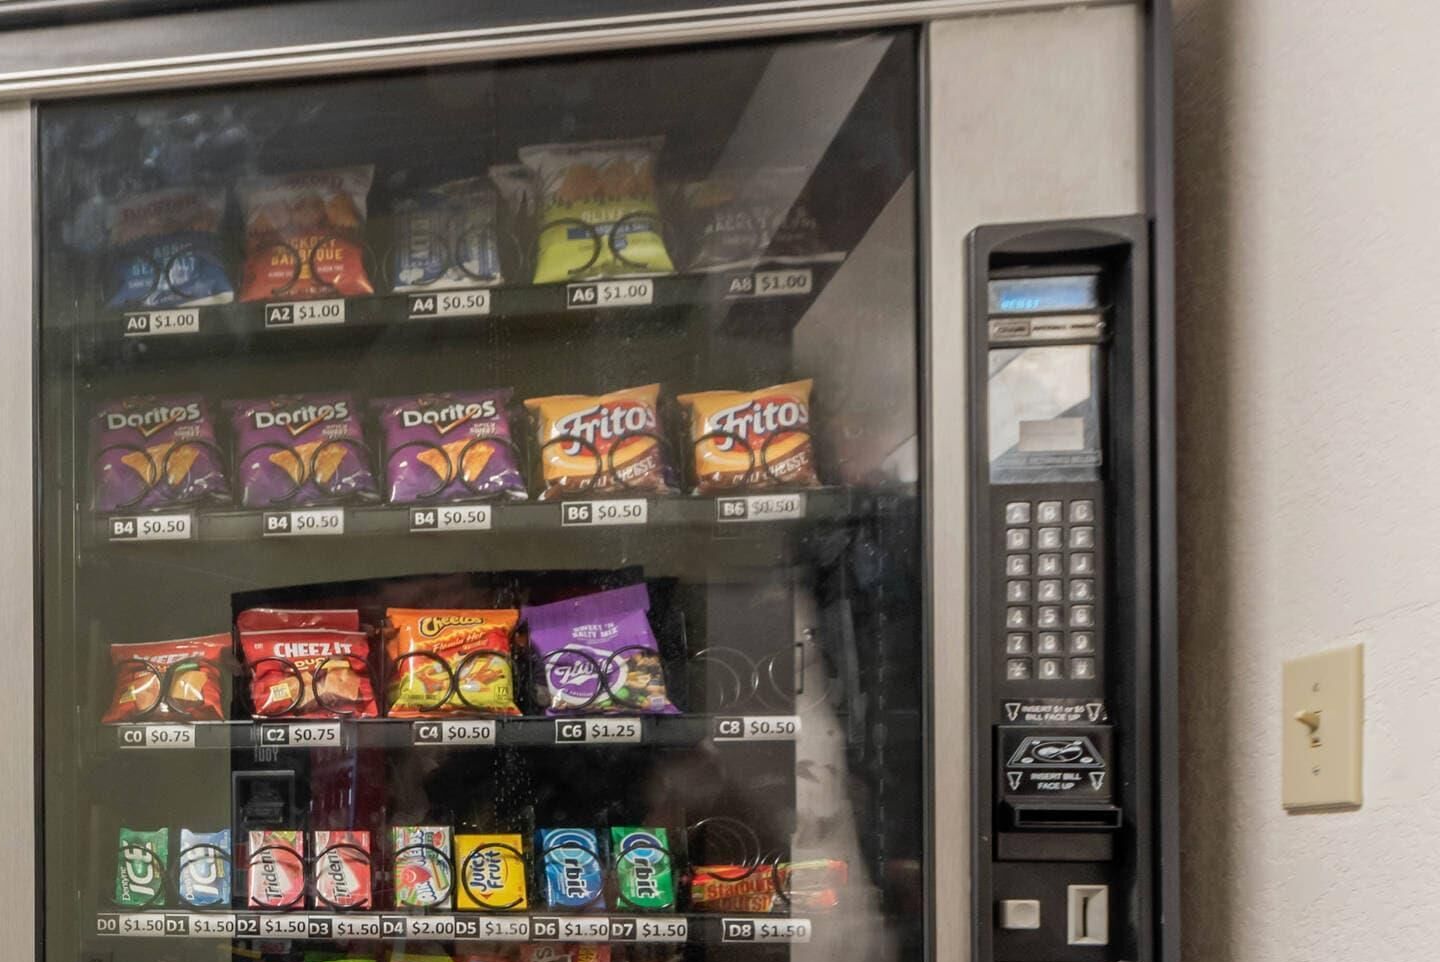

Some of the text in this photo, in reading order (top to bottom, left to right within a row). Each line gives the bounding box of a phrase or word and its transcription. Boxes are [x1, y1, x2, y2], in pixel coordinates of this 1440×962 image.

[729, 275, 807, 291] A8 $1.00
[572, 285, 648, 301] A6 $1.00
[413, 294, 485, 312] A4 $0.50
[270, 304, 340, 322] A2 $1.00
[127, 313, 194, 330] A0 $1.00
[107, 403, 200, 430] Doritos
[255, 402, 348, 429] Doritos
[403, 400, 495, 427] Doritos
[415, 510, 486, 526] B4 $0.50
[568, 504, 642, 520] B6 $0.50
[114, 519, 185, 535] B4 $0.50
[268, 514, 339, 530] B4 $0.50
[273, 642, 332, 658] CHEEZ
[266, 727, 335, 742] C2 $0.75
[419, 724, 491, 740] C4 $0.50
[561, 723, 635, 738] C6 $1.25
[719, 720, 796, 735] C8 $0.50
[124, 729, 191, 743] C0 $0.75
[122, 839, 155, 896] ICE
[263, 849, 283, 902] Trident
[326, 848, 352, 902] Trident
[470, 851, 488, 892] Juicy
[486, 850, 504, 889] Fruit
[97, 918, 164, 933] D0 $1.50
[166, 918, 234, 933] D1 $1.50
[237, 919, 306, 934] D2 $1.50
[309, 922, 379, 936] D3 $1.50
[383, 920, 454, 935] D4 $2.00
[455, 920, 528, 936] D5 $1.50
[535, 921, 608, 937] D6 $1.50
[612, 921, 687, 938] D7 $1.50
[729, 924, 806, 938] D8 $1.50
